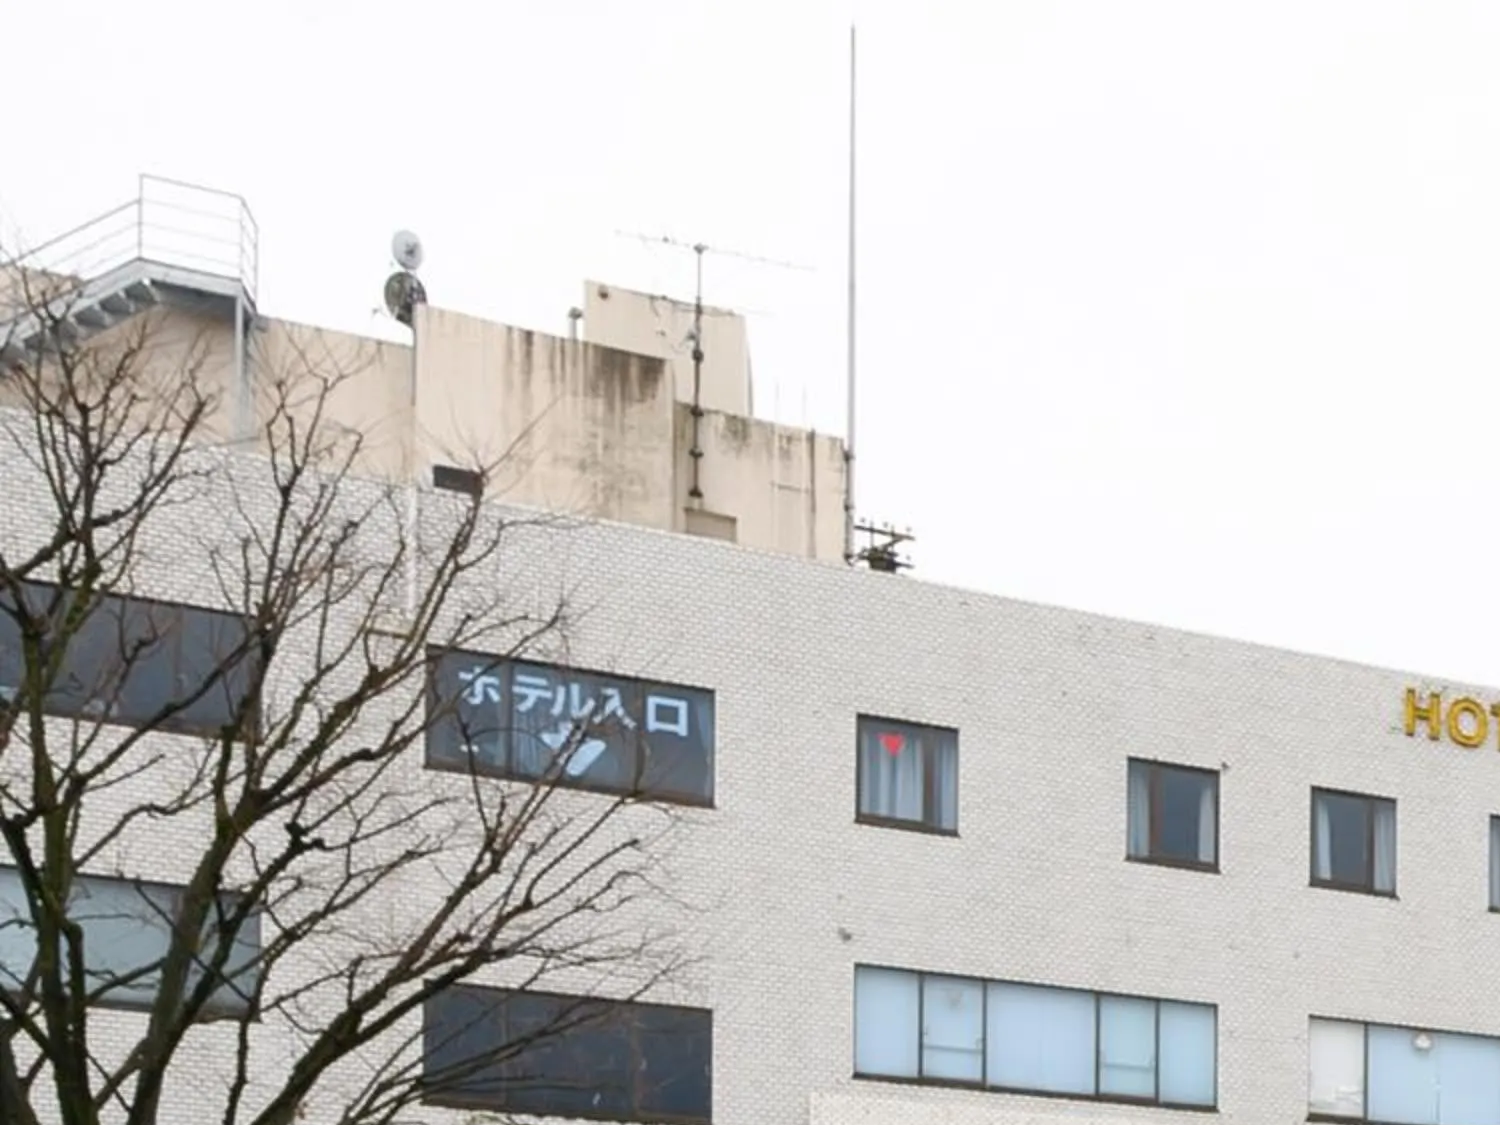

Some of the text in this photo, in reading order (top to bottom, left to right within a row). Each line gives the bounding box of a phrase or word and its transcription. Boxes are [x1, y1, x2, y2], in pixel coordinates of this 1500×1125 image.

[458, 666, 688, 737] ホテル入口
